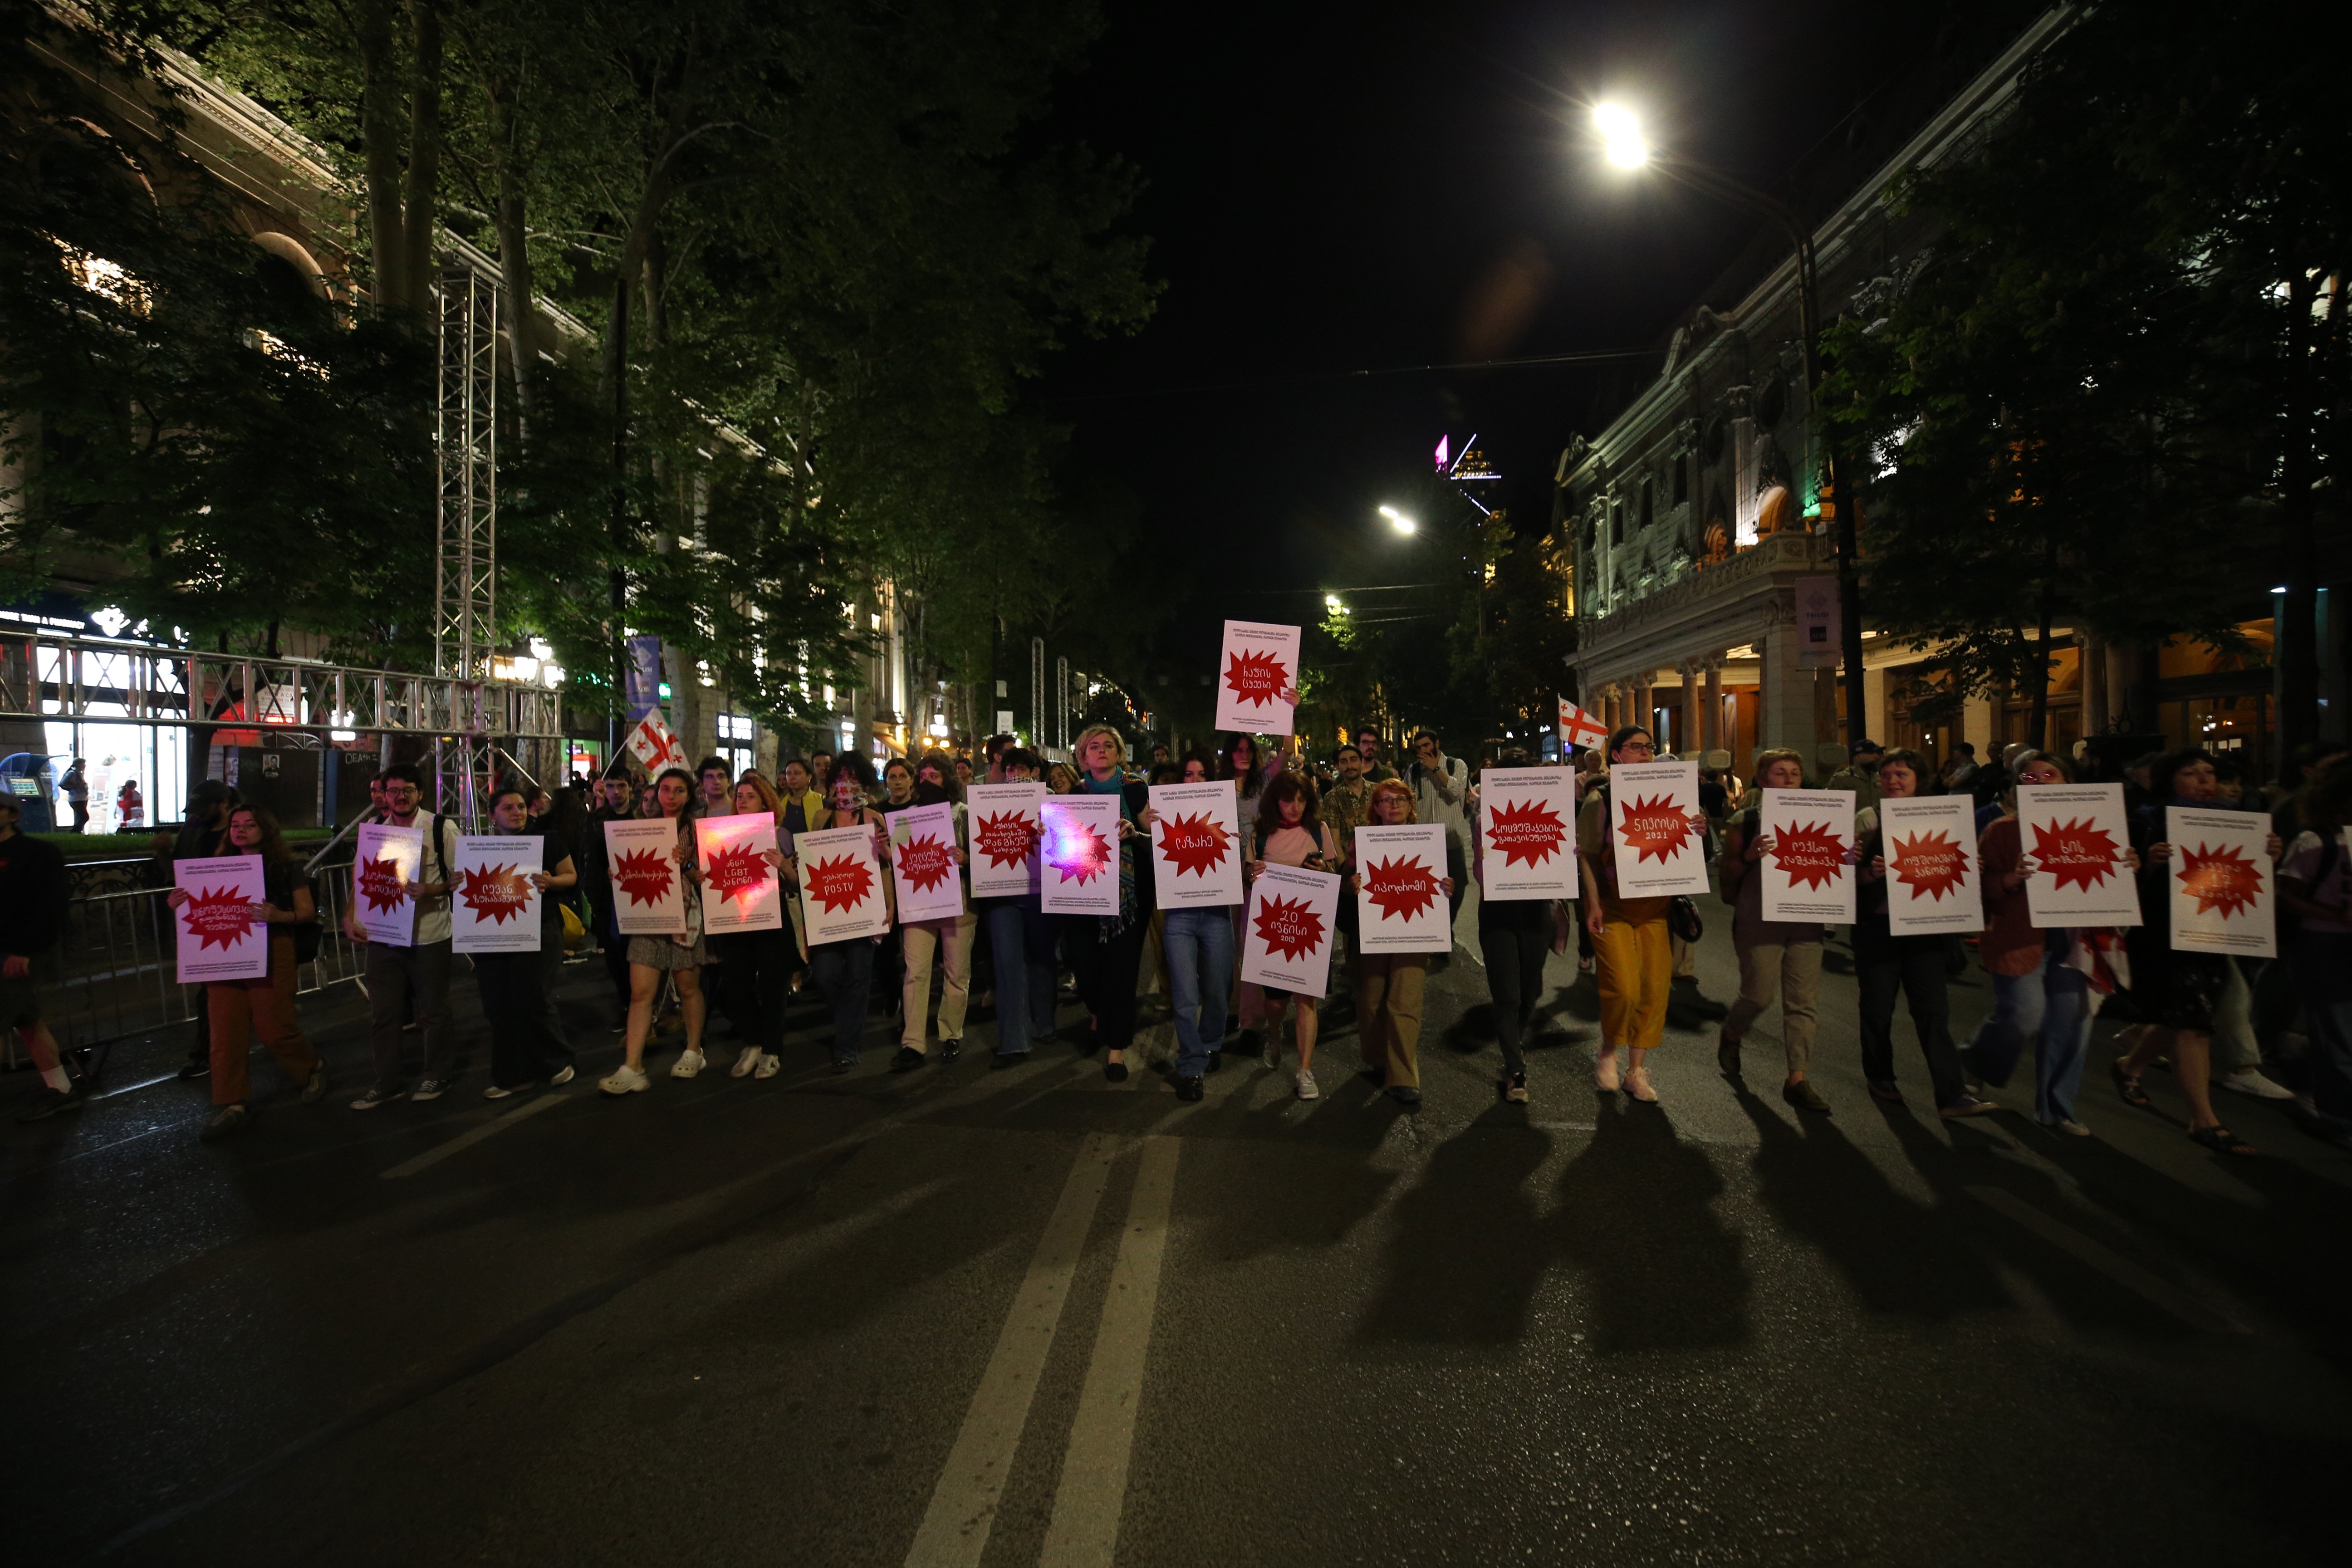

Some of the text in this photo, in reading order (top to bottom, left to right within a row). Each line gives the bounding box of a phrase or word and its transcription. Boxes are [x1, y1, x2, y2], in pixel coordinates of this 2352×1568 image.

[1243, 665, 1271, 678] რაჭის
[1242, 678, 1271, 689] ტყეები
[1495, 823, 1559, 833] სოცმუშაკების
[1634, 817, 1679, 832] 5 ივლისი
[1498, 833, 1556, 844] გათავისუფლება
[1646, 831, 1668, 840] 2021
[1176, 835, 1213, 850] ლაზარე
[909, 848, 939, 864] კულტურა
[726, 859, 745, 867] ანტი
[725, 868, 748, 877] LGBT
[822, 872, 854, 882] უბრალოდ
[1915, 865, 1951, 878] კანონი
[723, 876, 752, 887] კანონი
[1374, 879, 1426, 895] იპოდრომი
[482, 884, 513, 894] ლევან
[824, 882, 853, 896] POSTV
[1279, 910, 1298, 923] 20
[1271, 921, 1307, 936] ივნისი
[1280, 935, 1295, 944] 2019
